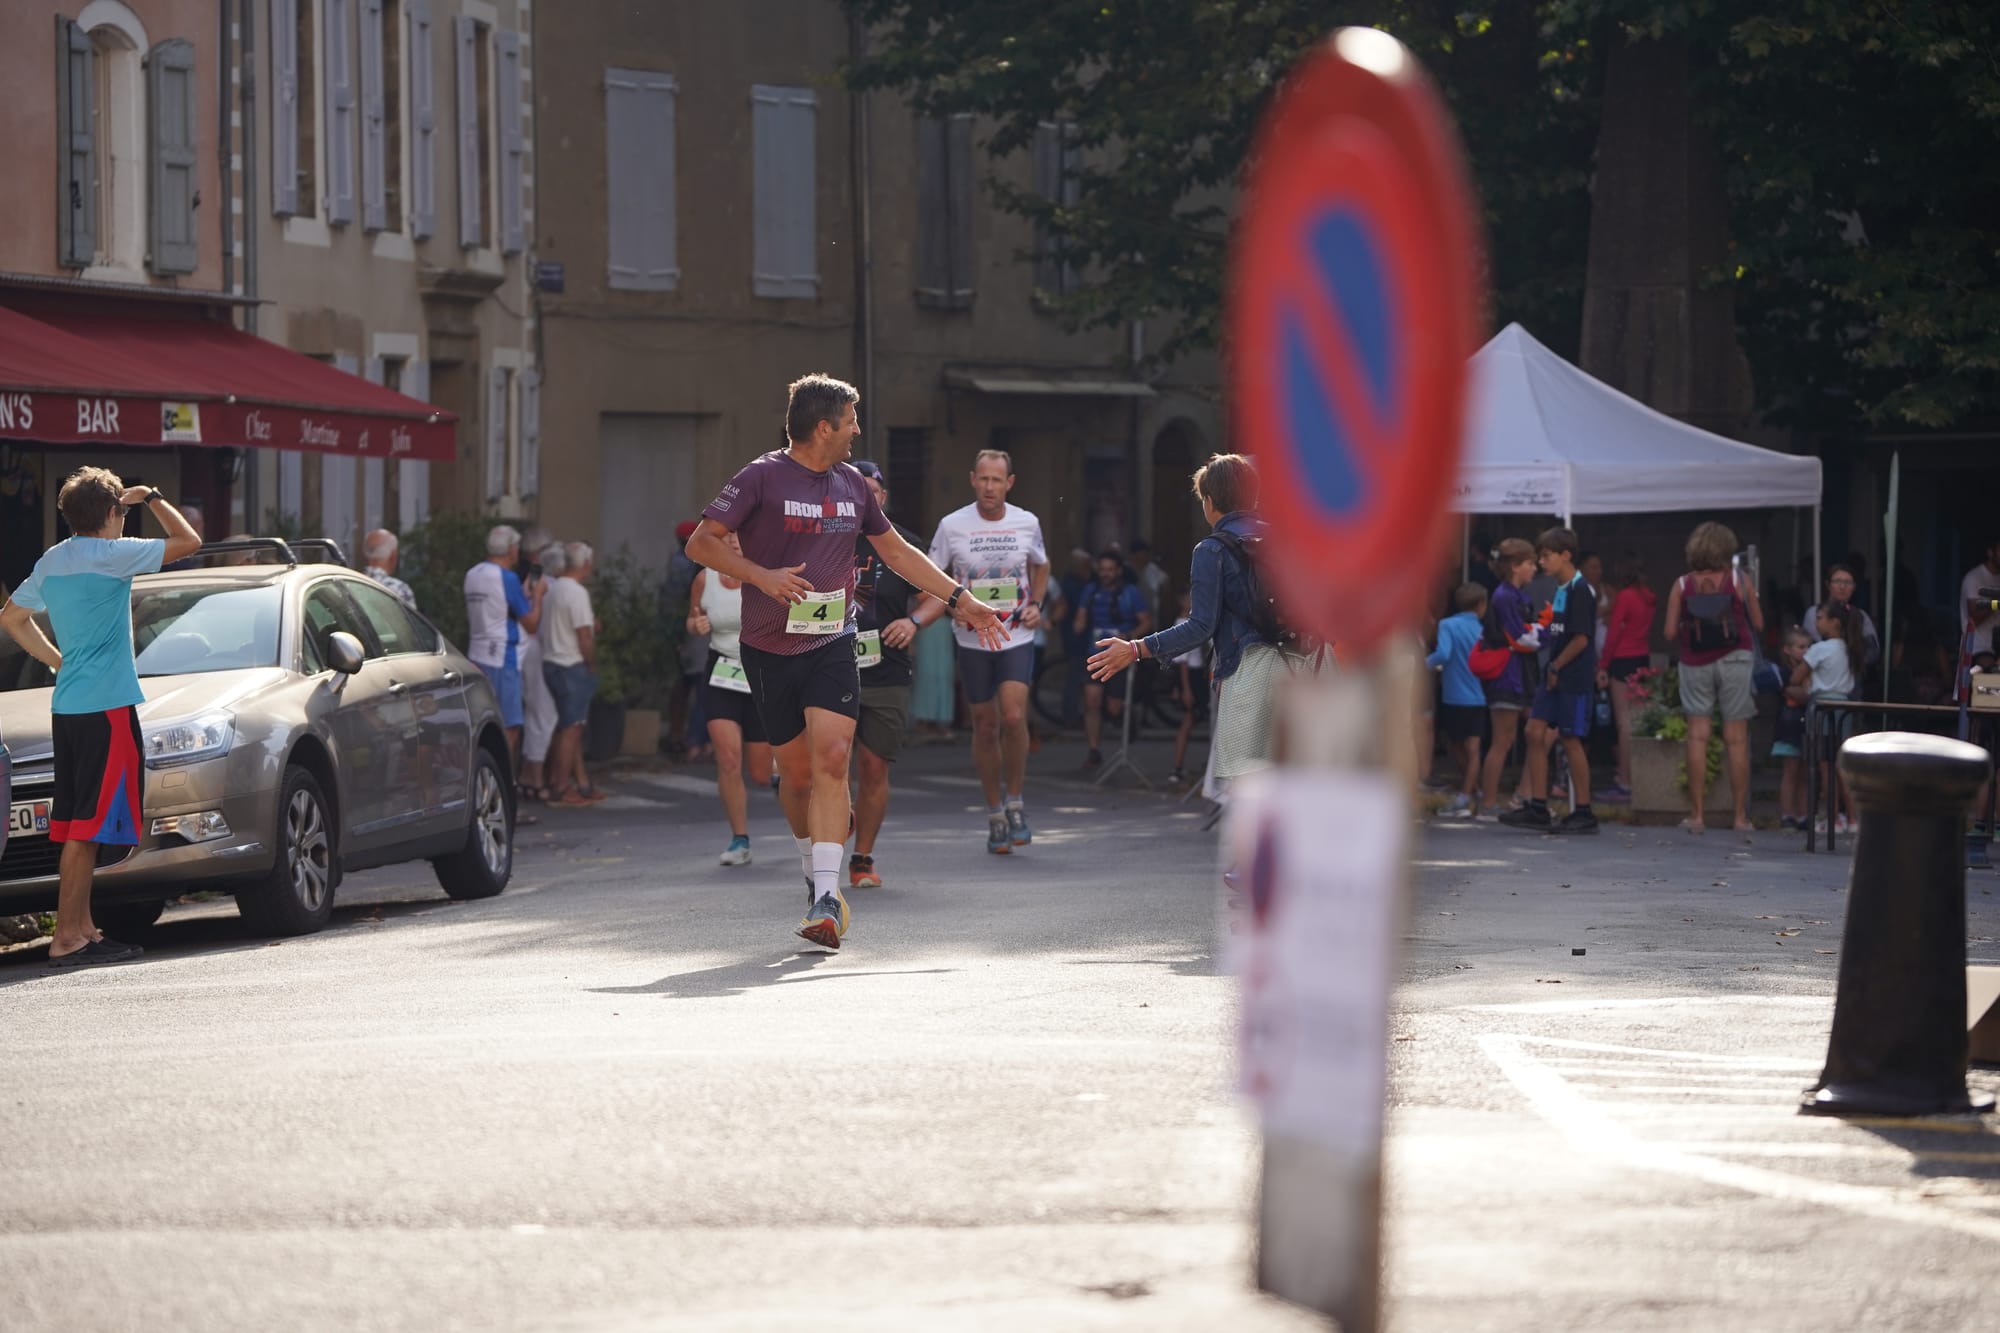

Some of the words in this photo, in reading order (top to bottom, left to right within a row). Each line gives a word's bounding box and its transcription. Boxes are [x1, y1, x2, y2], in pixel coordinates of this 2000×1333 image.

[77, 399, 119, 433] BAR
[246, 410, 271, 440] Chez
[300, 419, 340, 446] Martine
[358, 428, 369, 449] et
[389, 425, 411, 455] John
[989, 587, 1000, 600] 2
[812, 604, 828, 620] 4
[731, 666, 742, 678] 7
[36, 817, 48, 829] 48
